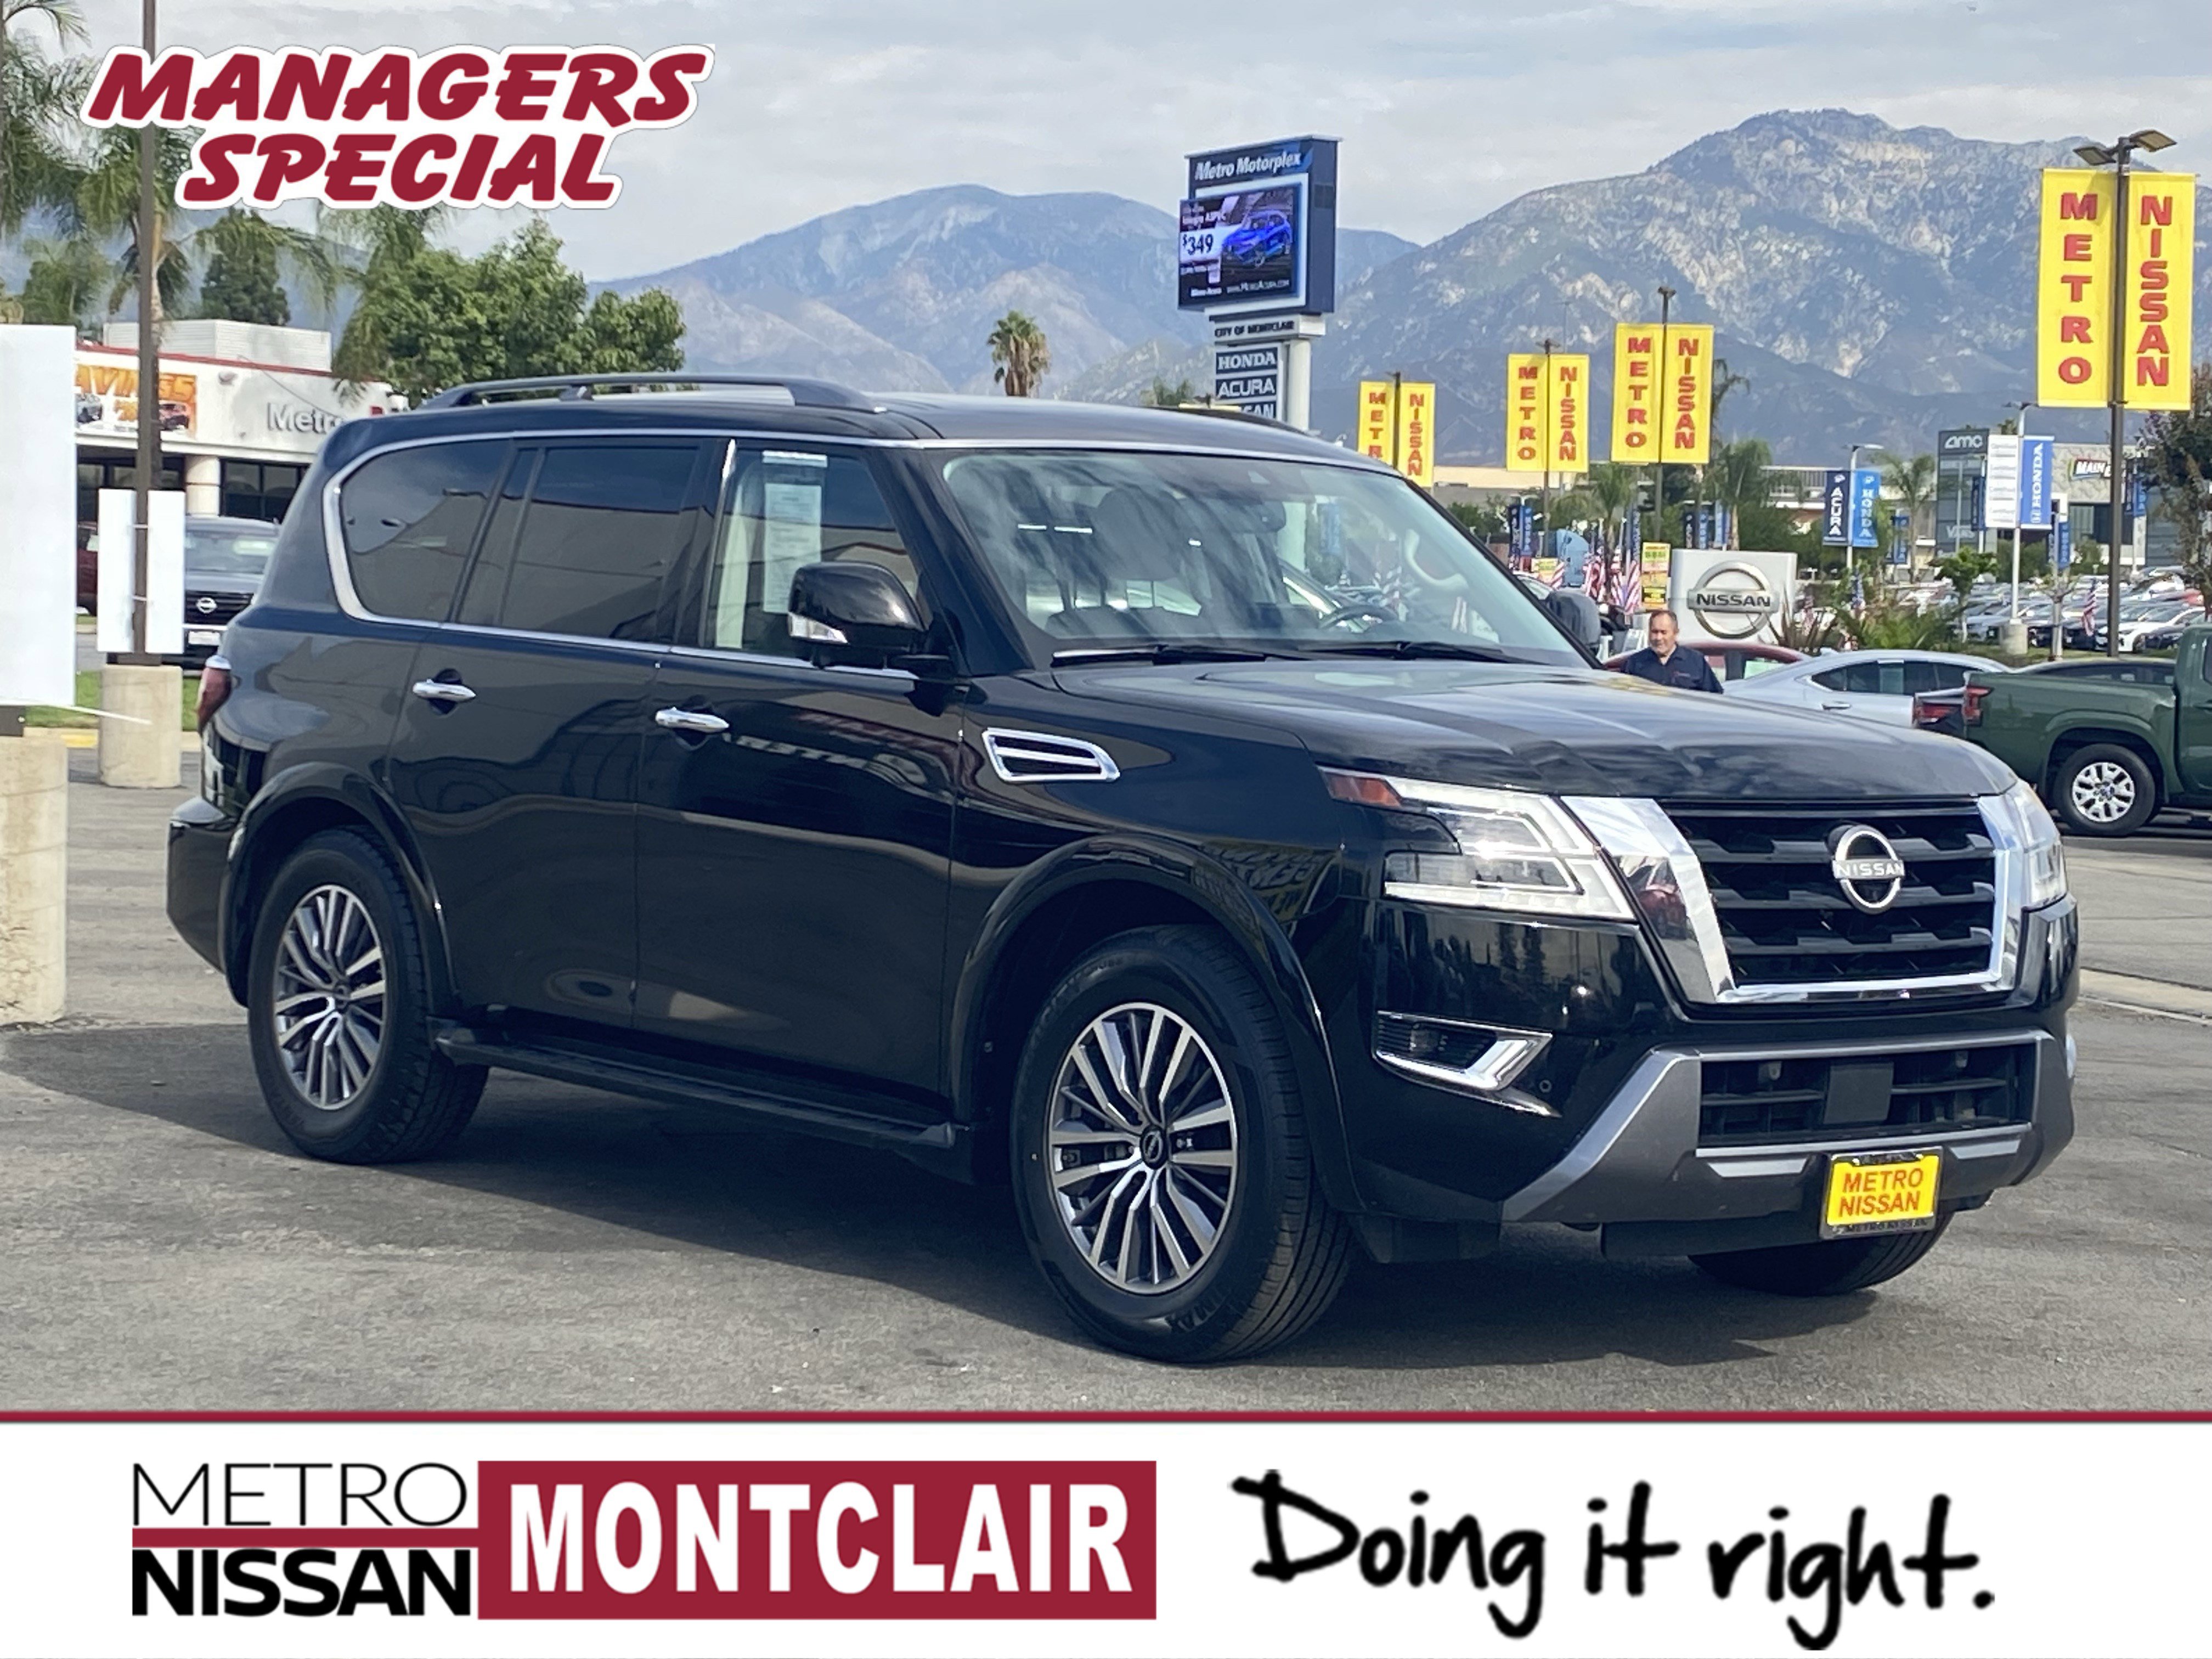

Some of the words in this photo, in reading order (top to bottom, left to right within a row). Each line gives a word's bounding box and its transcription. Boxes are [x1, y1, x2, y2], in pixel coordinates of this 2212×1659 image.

[1195, 161, 1234, 180] Metro
[1237, 151, 1301, 174] Motorplex
[1182, 234, 1214, 256] $349
[2058, 193, 2098, 384] METRO
[2136, 196, 2172, 386] NISSAN
[1234, 325, 1244, 335] OF
[1217, 351, 1276, 370] HONDA
[1217, 377, 1275, 399] ACURA
[1626, 337, 1651, 448] METRO
[1675, 338, 1699, 449] NISSAN
[1368, 392, 1386, 458] METR
[1407, 393, 1425, 476] NISSAN
[1517, 366, 1538, 460] METRO
[1559, 366, 1578, 461] NISSAN
[1944, 435, 1984, 449] amc
[2032, 443, 2044, 511] HONDA
[1829, 487, 1843, 536] ACURA
[1859, 489, 1874, 537] HONDA
[1696, 593, 1770, 607] NISSAN
[1836, 862, 1905, 877] NISSAN
[1838, 1190, 1920, 1217] NISSAN
[1842, 1168, 1923, 1193] METRO
